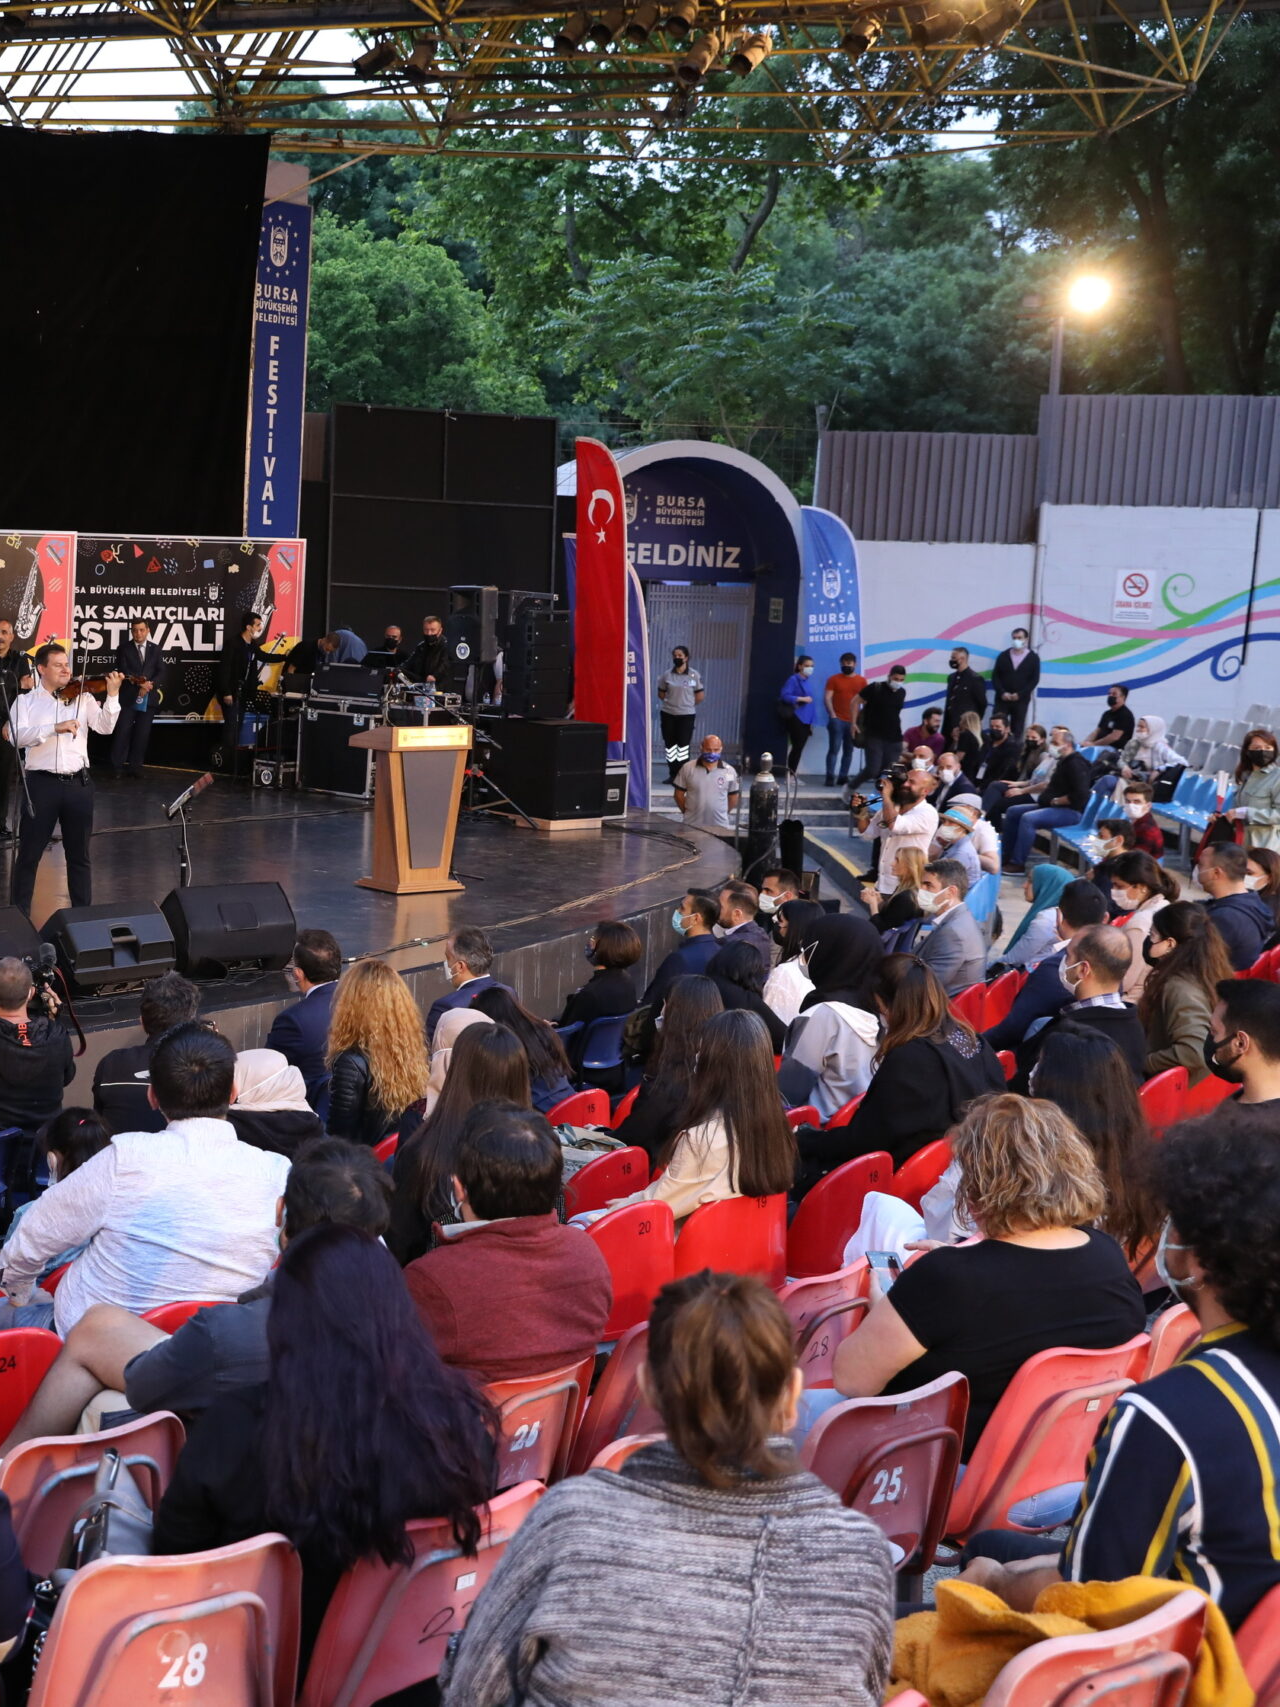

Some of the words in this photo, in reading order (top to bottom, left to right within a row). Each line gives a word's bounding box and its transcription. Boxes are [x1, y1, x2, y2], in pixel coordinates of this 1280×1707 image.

[656, 495, 706, 508] BURSA
[90, 585, 146, 596] BÜYÜKŞEHİR
[150, 587, 201, 596] BELEDİYESİ
[103, 605, 225, 623] SANATÇILARI
[809, 611, 856, 625] BURSA
[77, 655, 89, 664] BU
[638, 1221, 651, 1235] 20
[806, 1335, 829, 1364] 28
[869, 1465, 904, 1505] 25
[157, 1642, 208, 1688] 28
